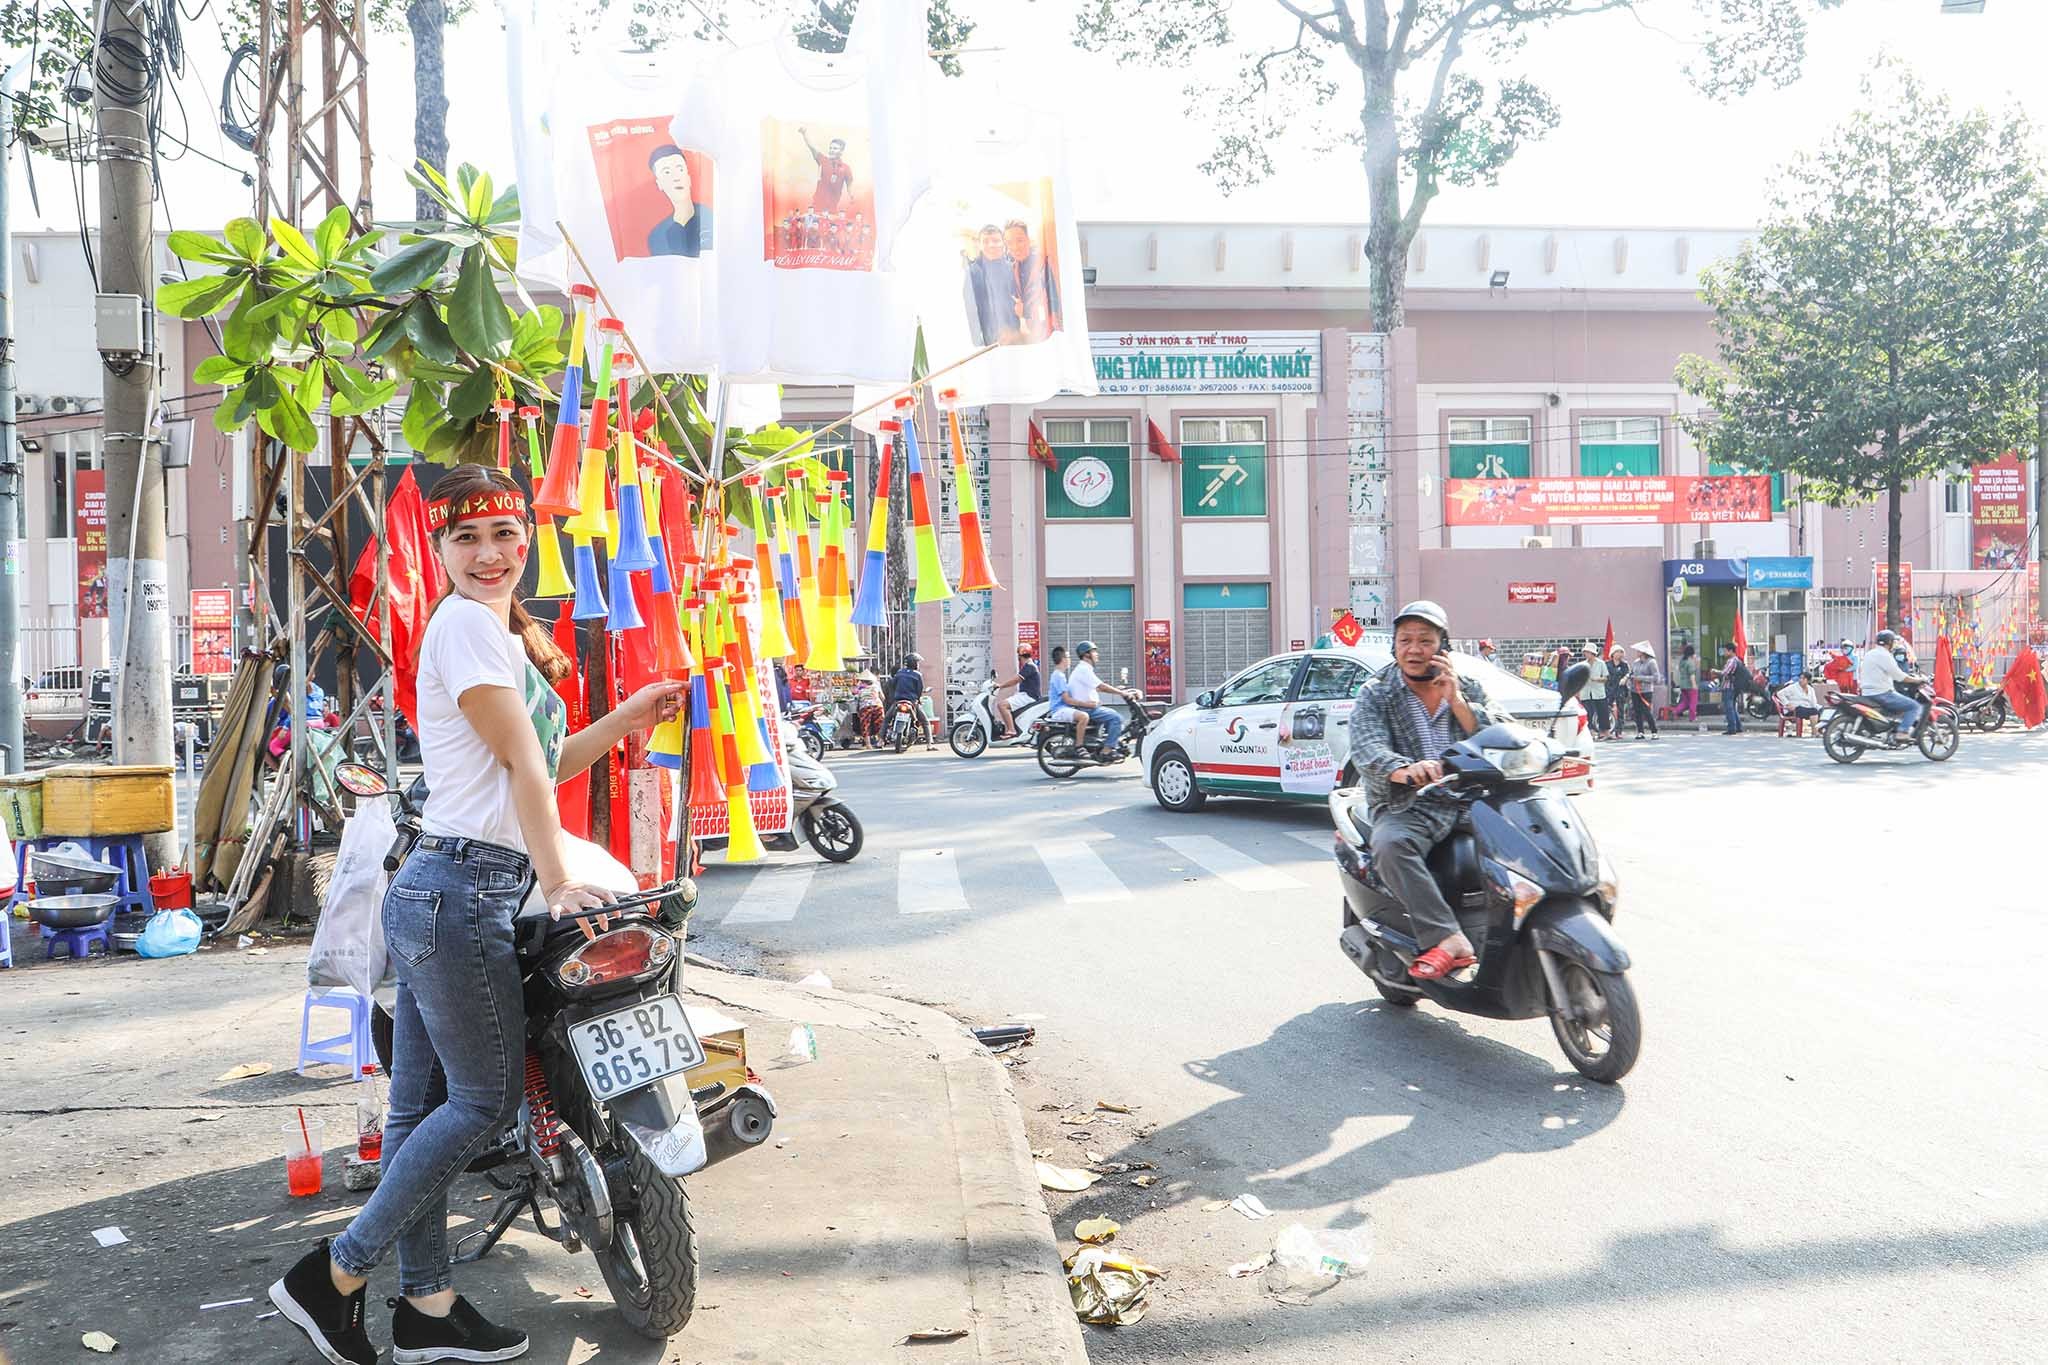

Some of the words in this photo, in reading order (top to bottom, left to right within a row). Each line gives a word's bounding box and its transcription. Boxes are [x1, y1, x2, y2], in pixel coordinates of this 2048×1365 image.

[1185, 336, 1193, 345] &
[1221, 336, 1248, 345] THAO
[1093, 356, 1124, 379] UNG
[1128, 351, 1162, 379] TÂM
[1166, 355, 1209, 379] TDTT
[1211, 347, 1268, 379] THỐNG
[1271, 347, 1313, 379] NHẤT
[428, 506, 439, 527] ỆT
[440, 500, 471, 519] NM
[493, 493, 514, 510] VÔ
[1691, 511, 1711, 521] U23
[1713, 510, 1735, 521] VIỆT
[1736, 510, 1760, 520] NAM
[1680, 564, 1705, 575] ACB
[1085, 586, 1095, 599] A
[1220, 585, 1231, 597] A
[1081, 600, 1099, 608] VIP
[586, 1004, 673, 1056] 36-B2
[590, 1033, 695, 1093] 865.79
